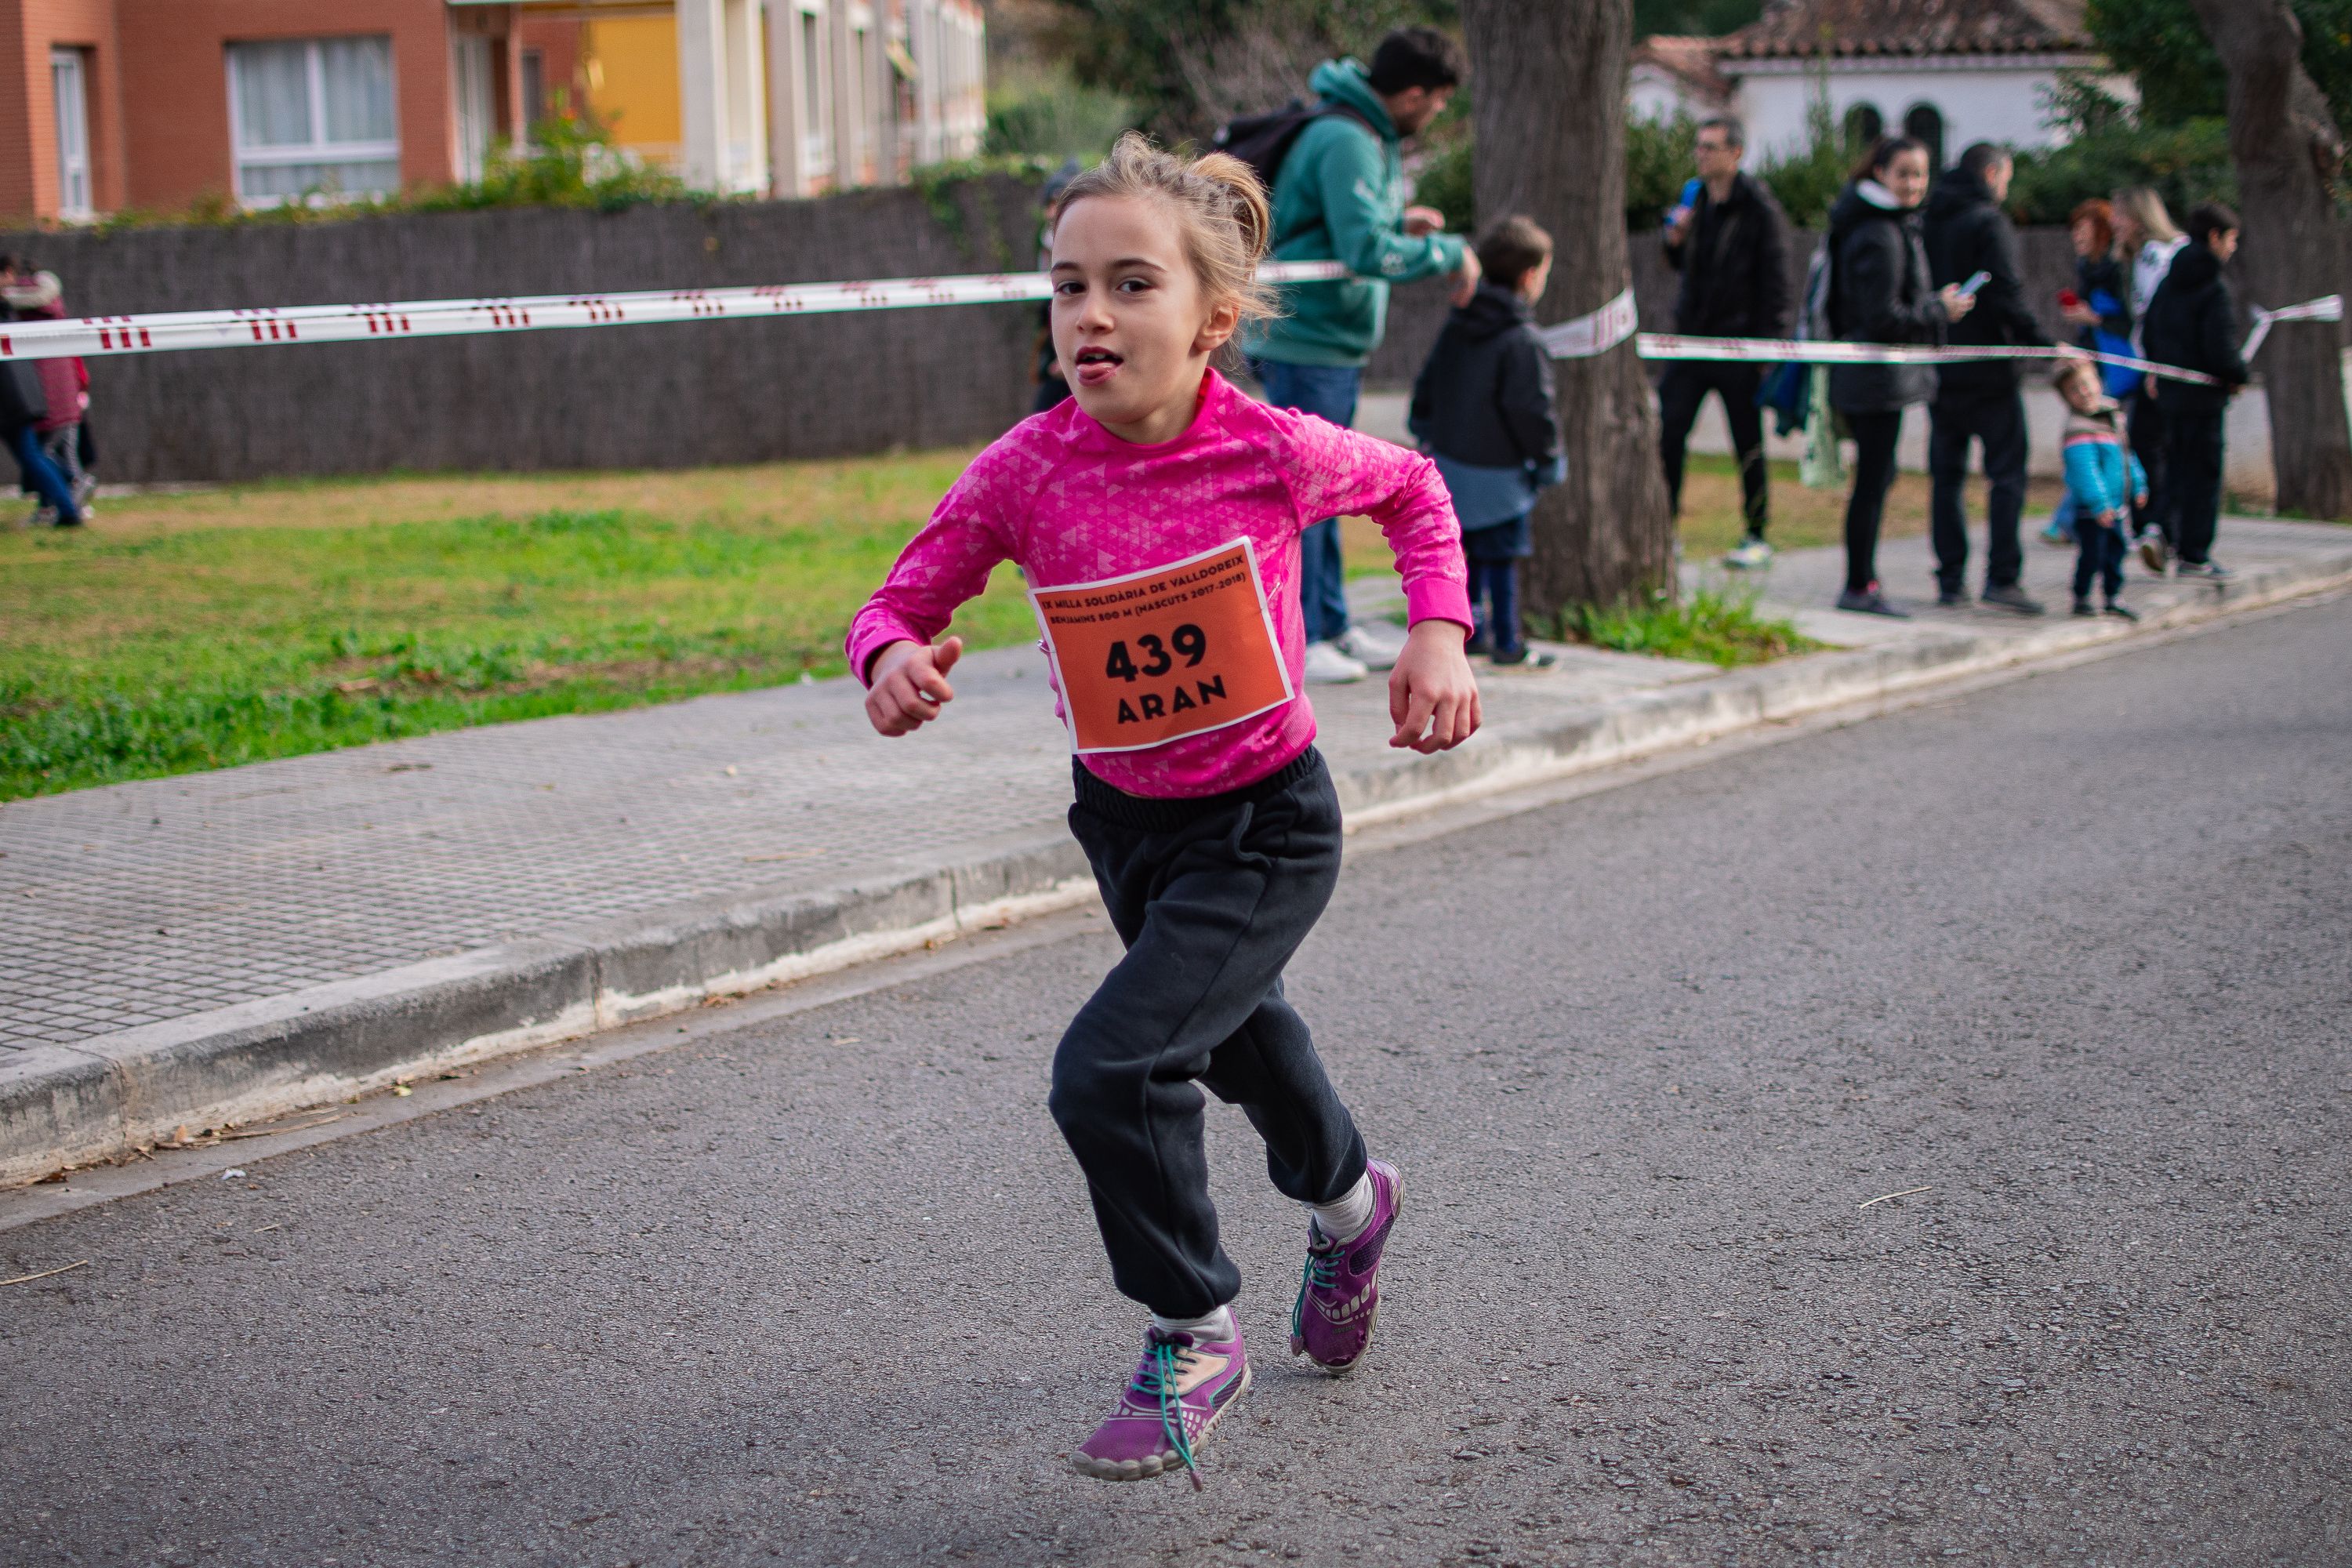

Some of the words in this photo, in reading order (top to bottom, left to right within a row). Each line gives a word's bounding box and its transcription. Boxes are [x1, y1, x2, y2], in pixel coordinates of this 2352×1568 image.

[1042, 601, 1052, 609] IX
[1054, 600, 1082, 608] MILLA
[1085, 590, 1146, 607] SOLIDÀRIA
[1149, 582, 1167, 594] DE
[1170, 555, 1243, 587] VALLDOREIX
[1051, 615, 1096, 624] BENJAMINS
[1099, 611, 1120, 622] 800
[1123, 608, 1132, 617] M
[1135, 593, 1189, 617] (NASCUTS
[1191, 572, 1246, 599] 2017-2018)
[1106, 624, 1206, 682] 439
[1118, 675, 1227, 724] ARAN
